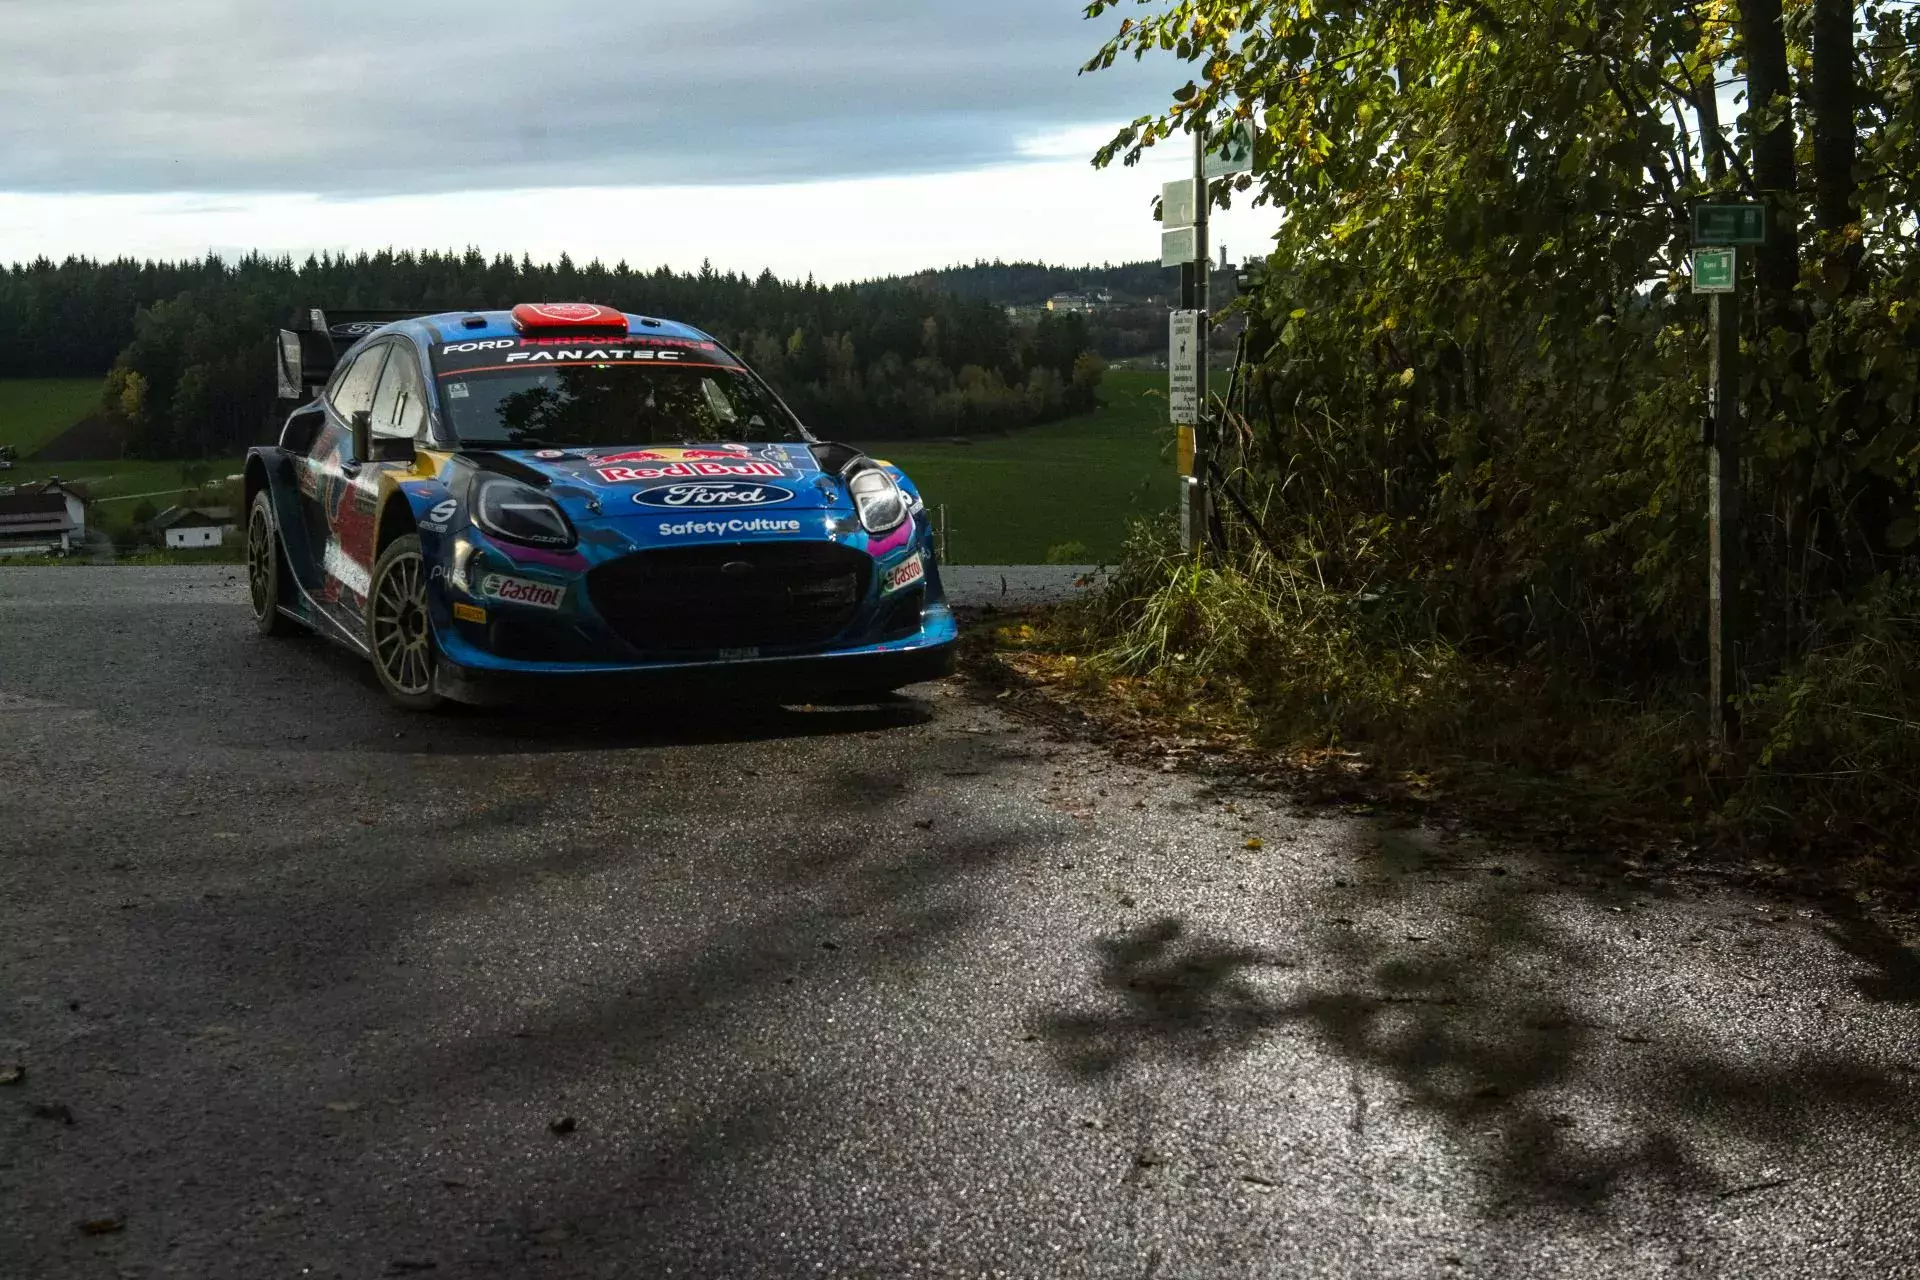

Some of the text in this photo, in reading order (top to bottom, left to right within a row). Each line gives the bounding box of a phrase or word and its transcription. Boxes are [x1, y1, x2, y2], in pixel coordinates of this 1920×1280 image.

[443, 339, 515, 355] FORD
[506, 350, 679, 362] FANATEC
[598, 462, 785, 482] Red Bull
[663, 484, 767, 505] Ford
[659, 518, 800, 536] SafetyCulture
[500, 579, 561, 606] Castrol
